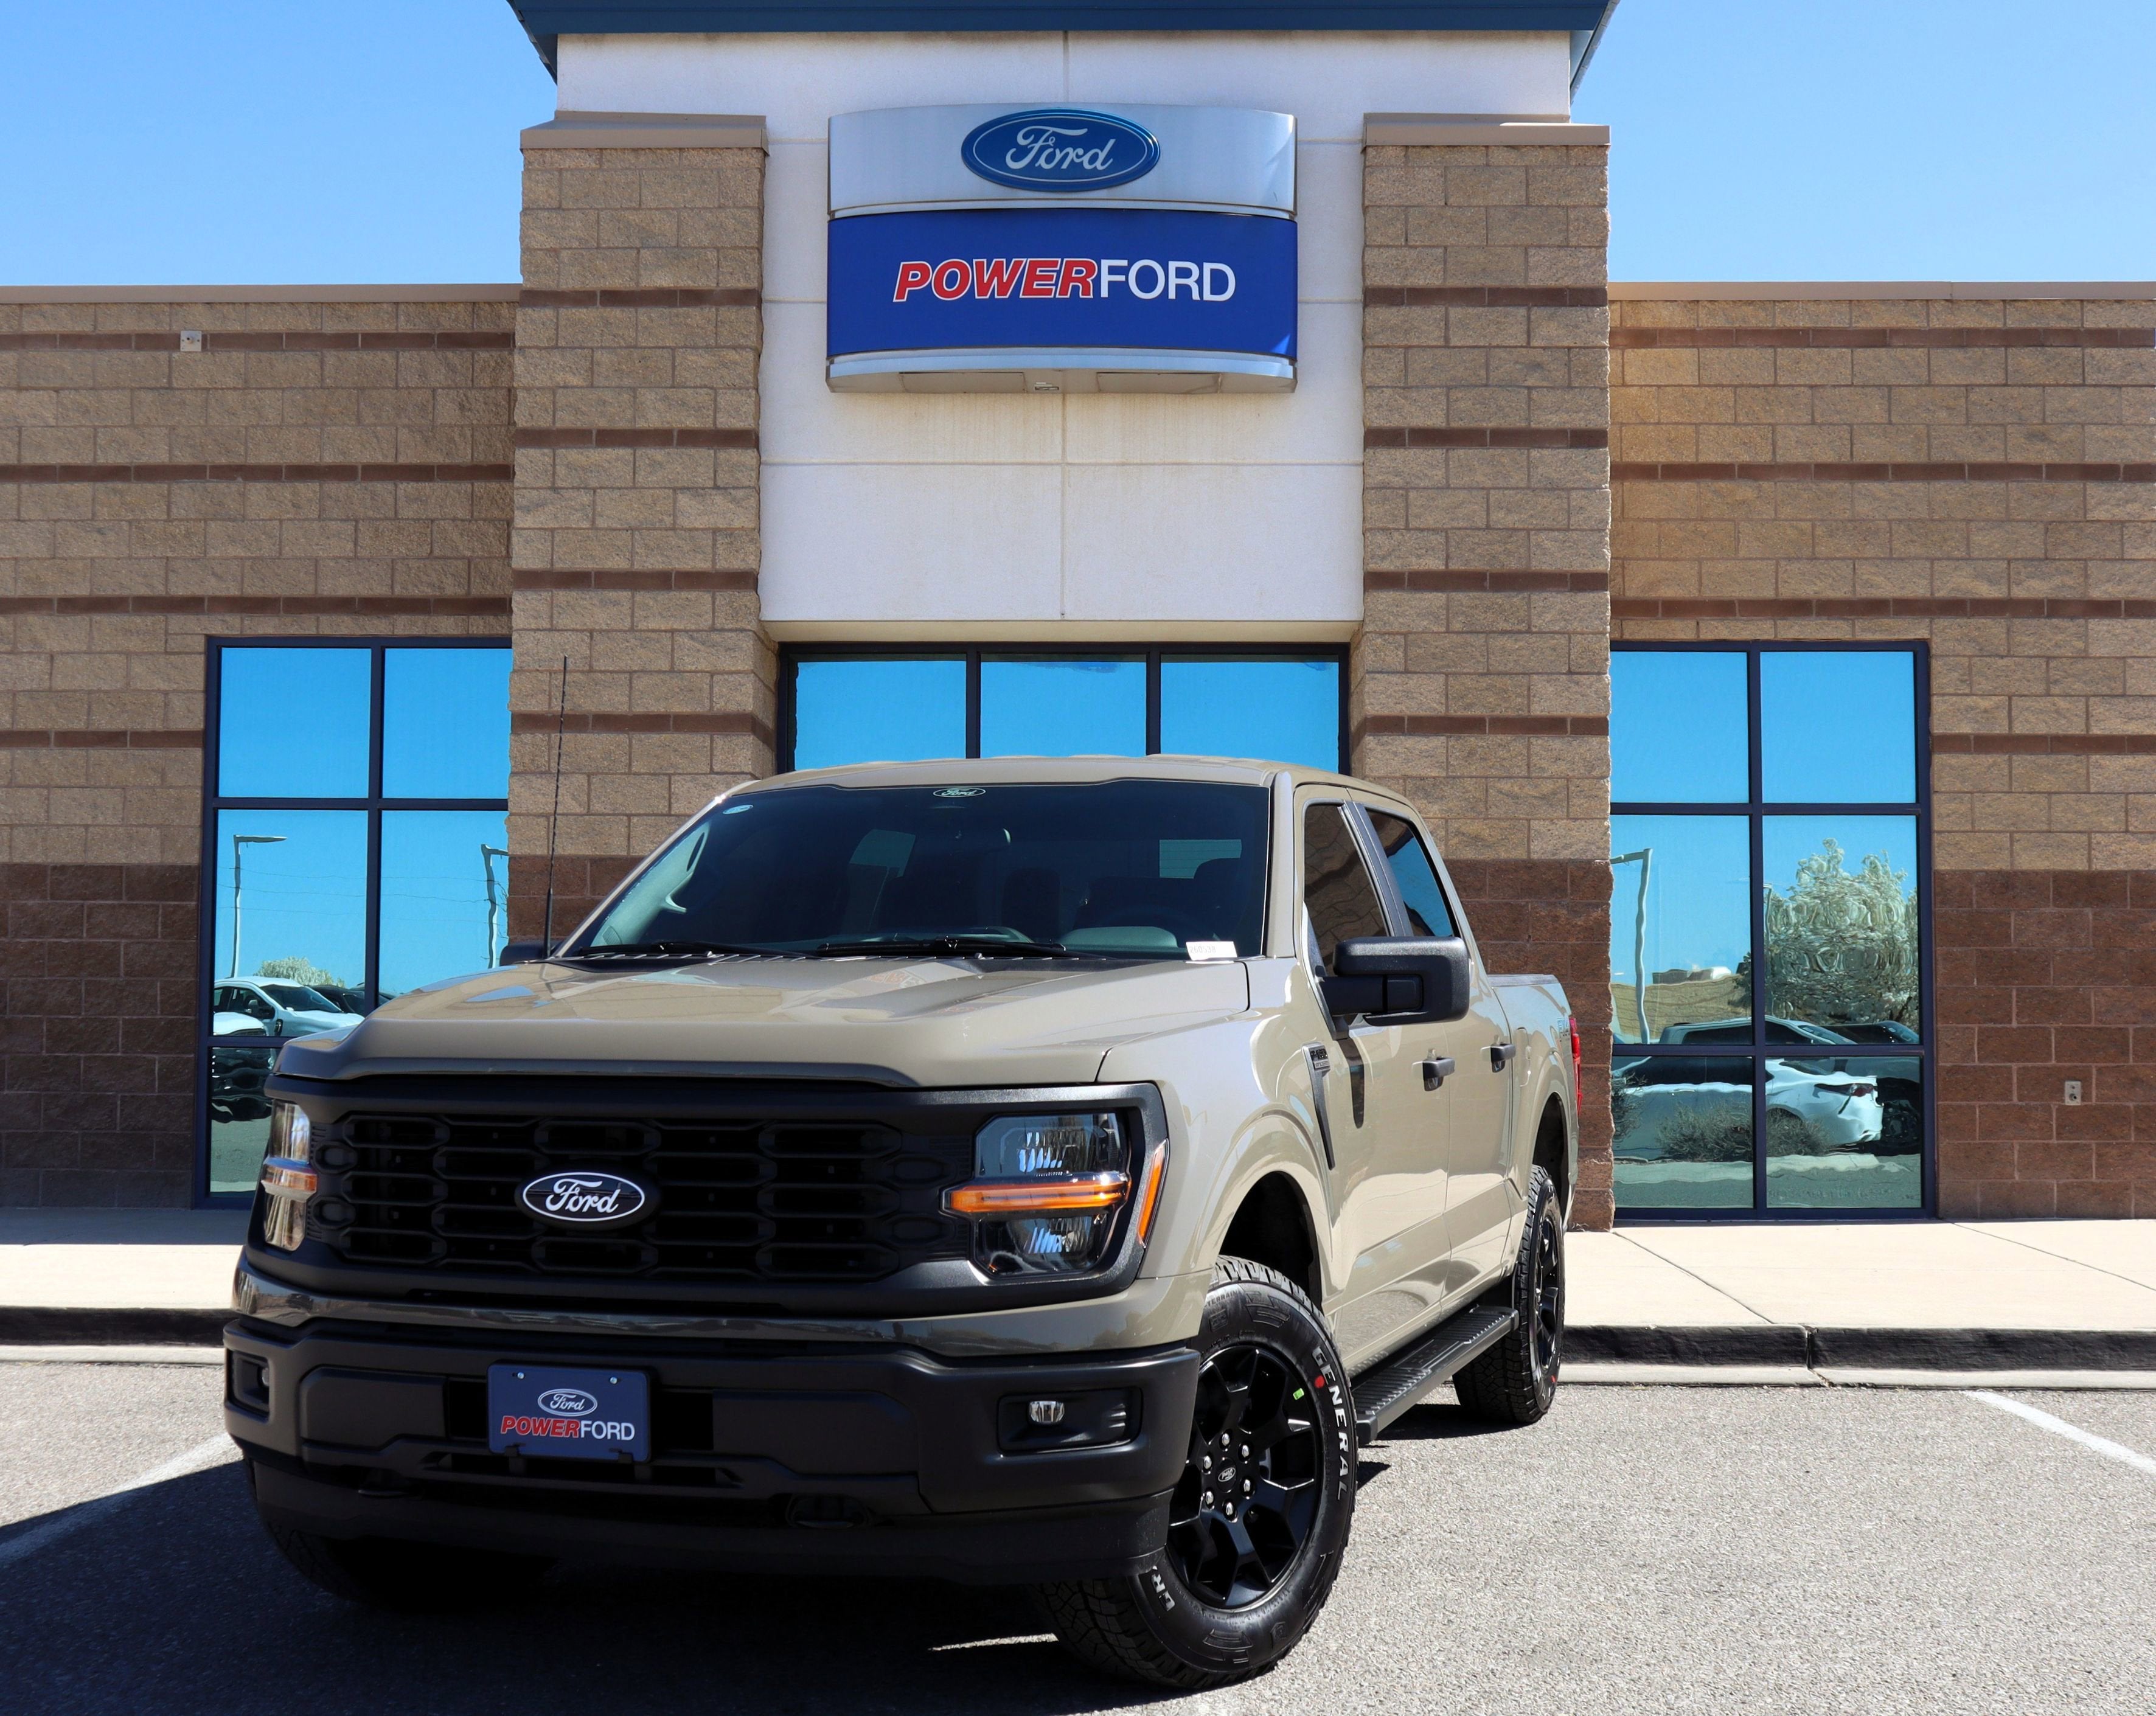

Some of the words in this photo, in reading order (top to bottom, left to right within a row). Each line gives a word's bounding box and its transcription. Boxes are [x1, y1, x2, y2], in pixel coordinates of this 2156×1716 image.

[1005, 125, 1117, 171] Ford
[545, 1178, 621, 1213] Ford
[550, 1393, 585, 1411] Ford
[1312, 1346, 1349, 1501] GENERAL
